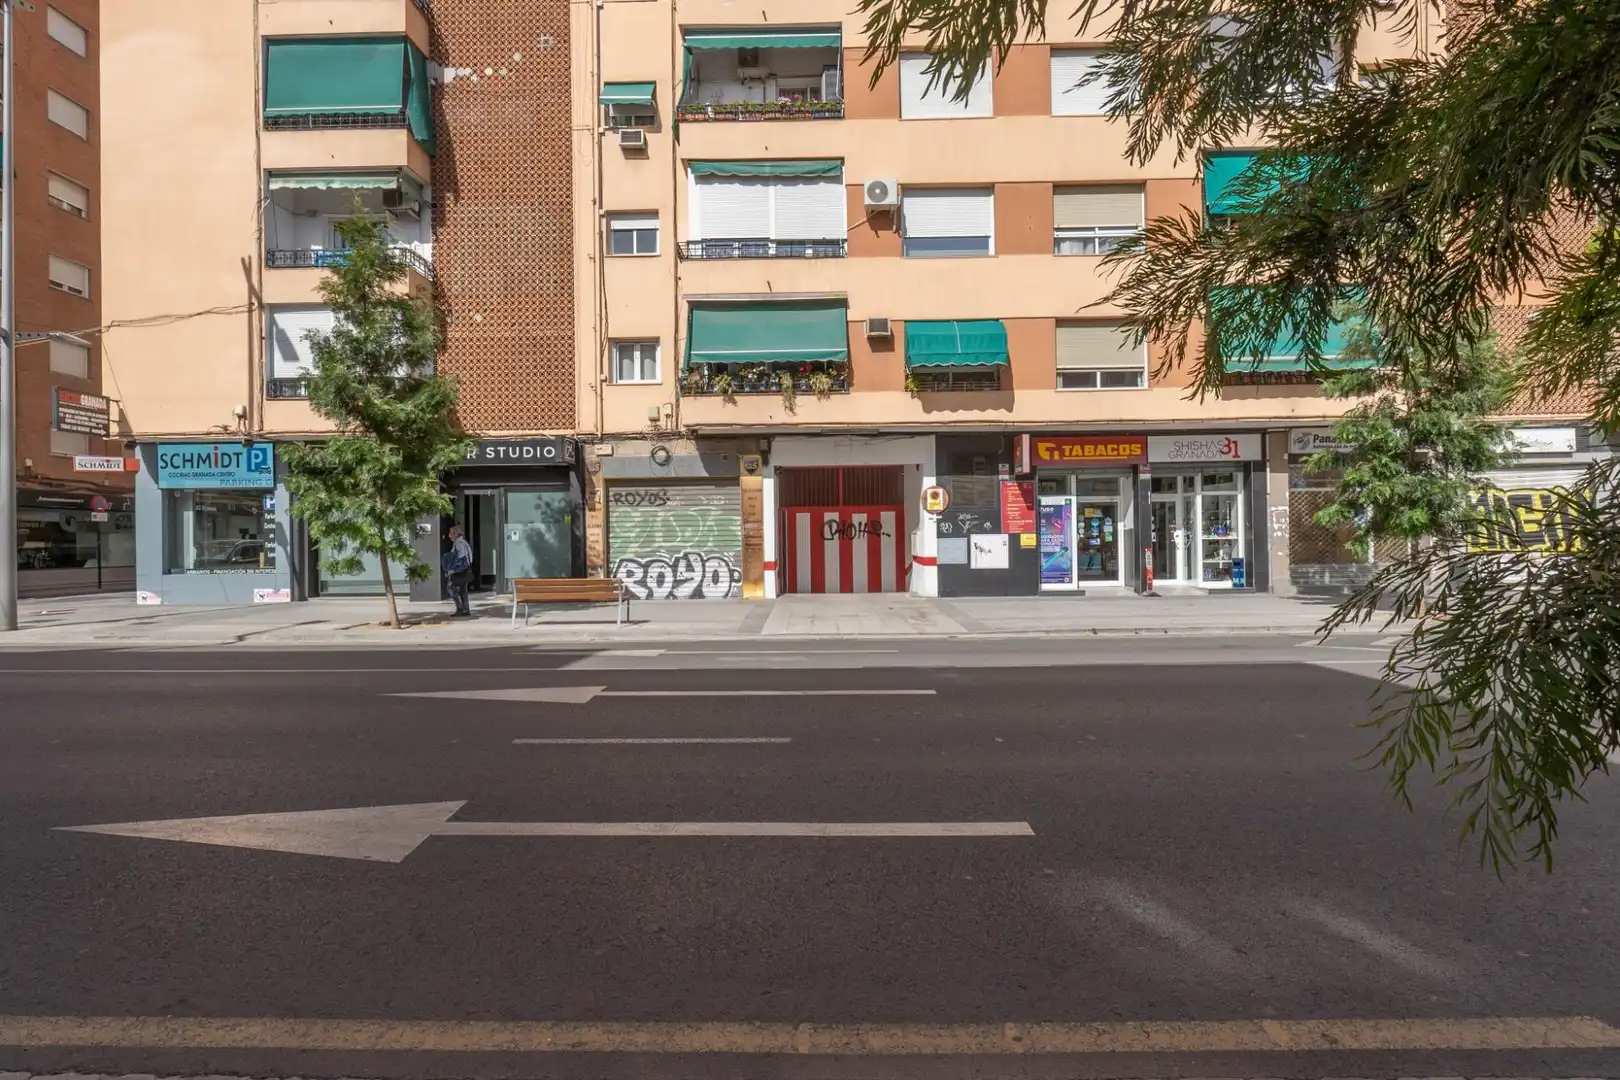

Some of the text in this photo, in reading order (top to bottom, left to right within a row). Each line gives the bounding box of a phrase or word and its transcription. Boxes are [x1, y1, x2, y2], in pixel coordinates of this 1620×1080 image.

[1062, 444, 1142, 456] TABACOS
[1174, 440, 1226, 451] SHISHAS
[1220, 437, 1240, 458] 31
[486, 446, 556, 458] STUDIO
[1168, 450, 1222, 460] GRANADA
